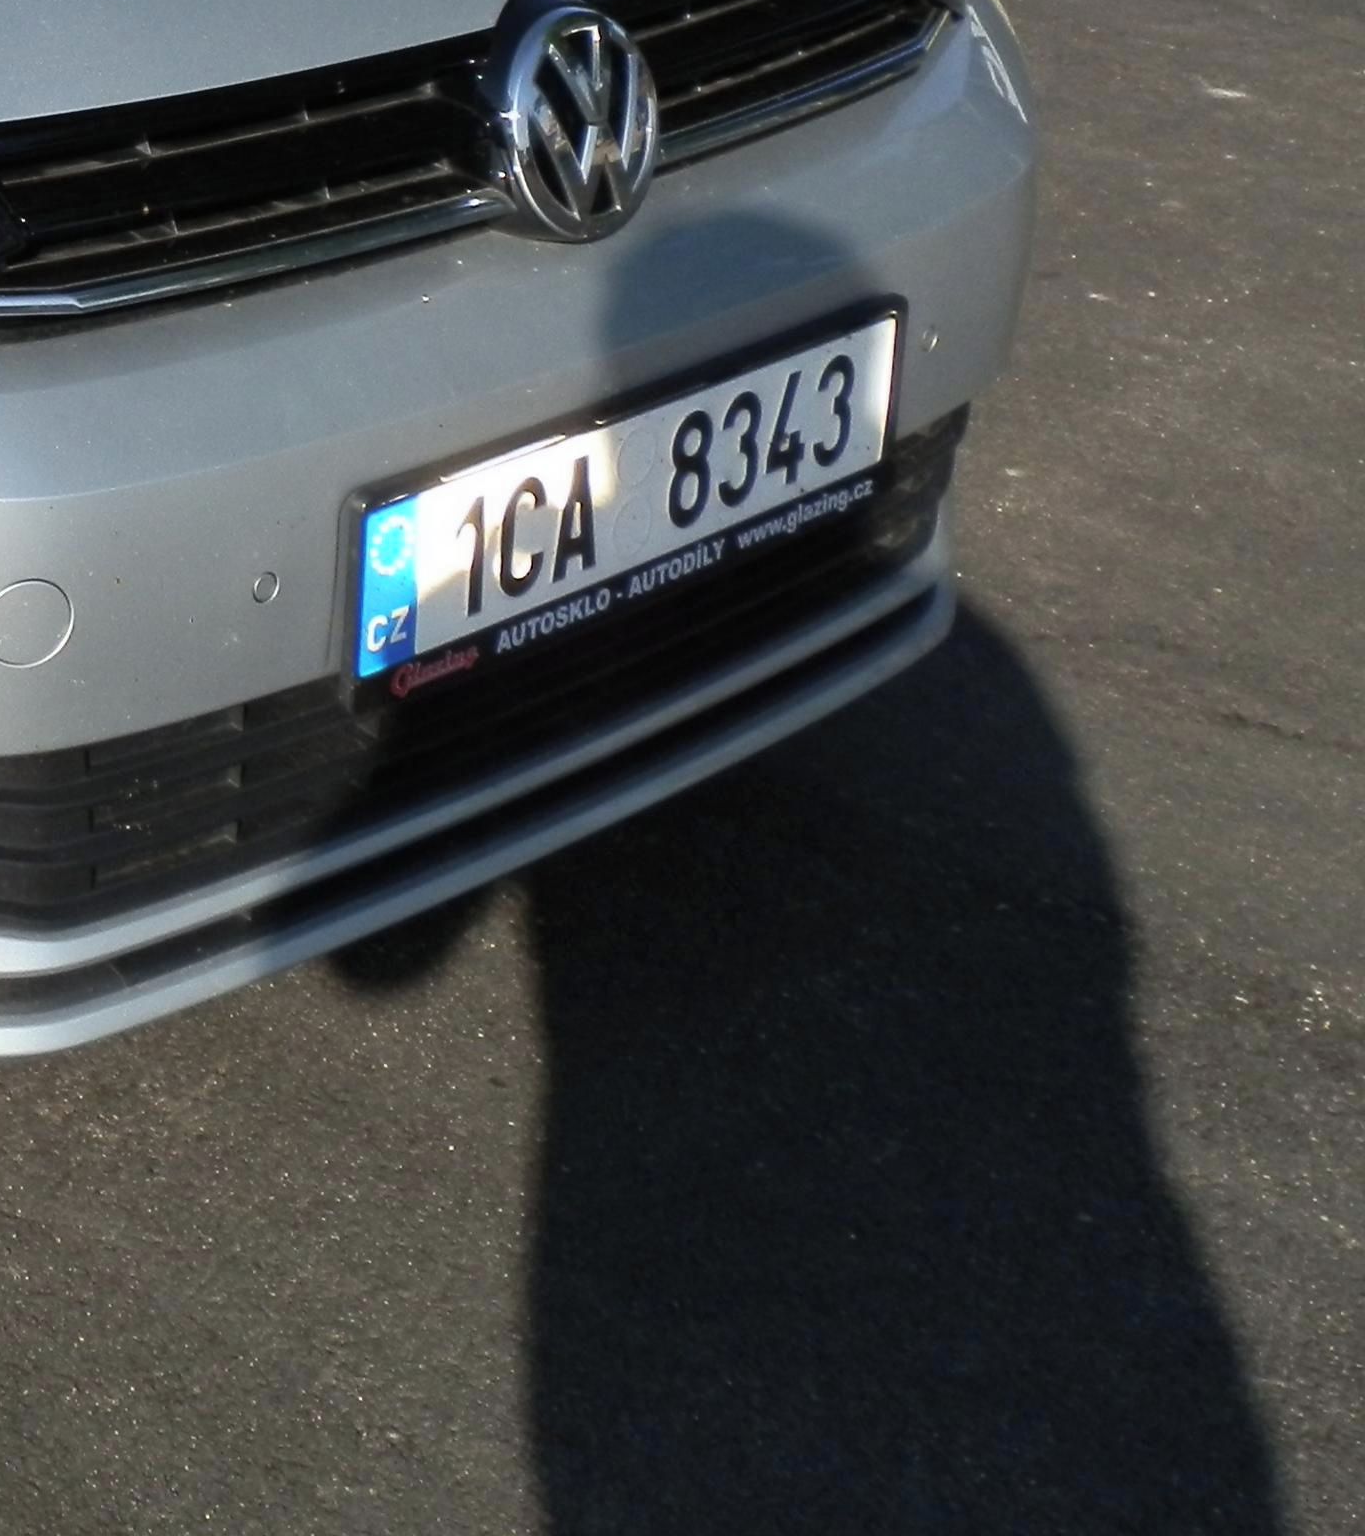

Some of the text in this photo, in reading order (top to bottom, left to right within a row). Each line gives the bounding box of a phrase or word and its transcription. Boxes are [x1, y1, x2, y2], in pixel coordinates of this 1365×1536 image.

[455, 355, 855, 616] 1CA 8343
[496, 587, 611, 654] AUTOSKLO
[628, 538, 726, 599] AUTODÍLY
[736, 479, 874, 549] www.glazing.cz
[366, 605, 410, 653] CZ
